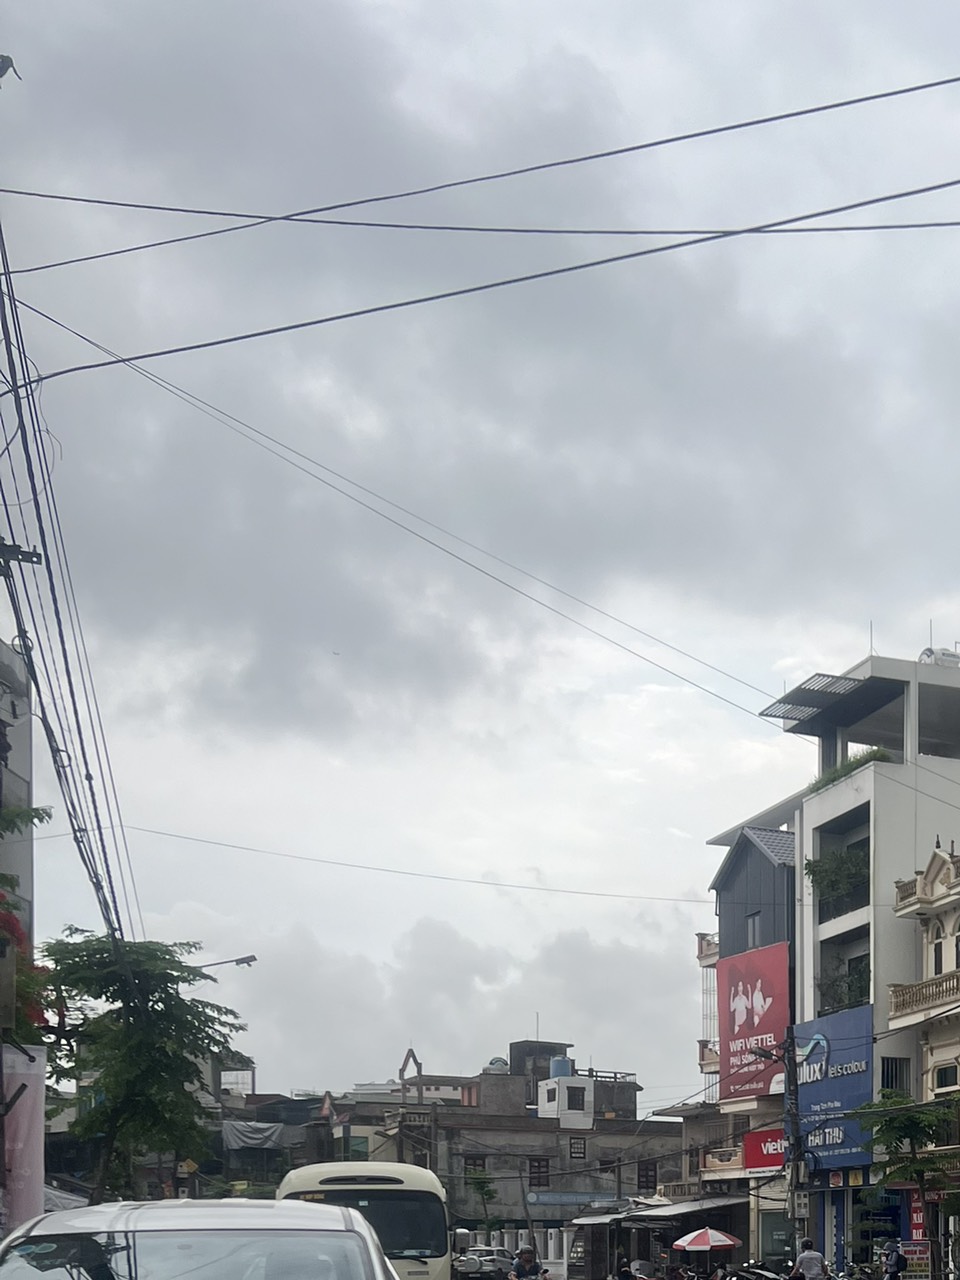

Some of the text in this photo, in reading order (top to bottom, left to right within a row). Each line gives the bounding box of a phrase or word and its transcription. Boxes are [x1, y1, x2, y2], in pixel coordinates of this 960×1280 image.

[729, 1033, 776, 1052] WIFI VIETTEL
[796, 1061, 821, 1085] ulux
